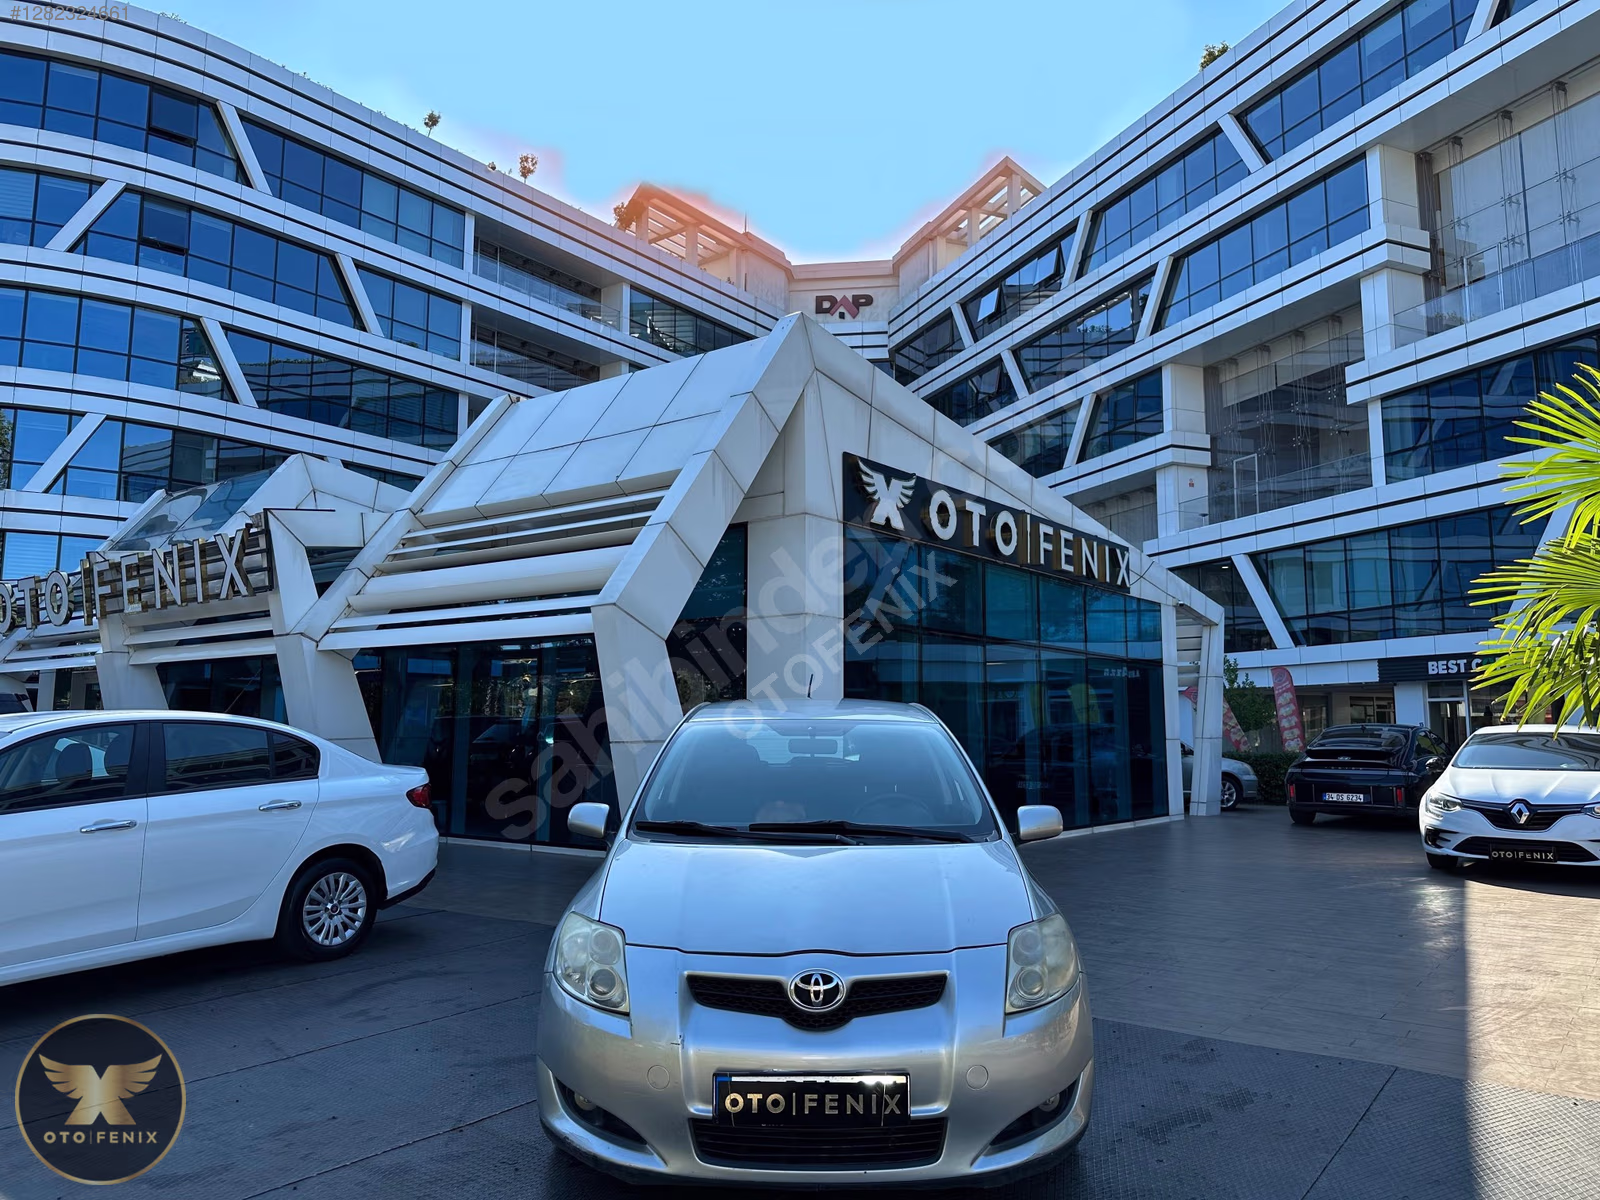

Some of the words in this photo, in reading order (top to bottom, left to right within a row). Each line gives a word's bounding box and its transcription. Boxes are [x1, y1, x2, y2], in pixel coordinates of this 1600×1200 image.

[815, 293, 874, 319] DAP
[928, 489, 1018, 556] OTO
[1038, 521, 1130, 588] FENIX
[93, 528, 250, 618] FENIX
[1427, 659, 1467, 675] BEST
[1518, 851, 1554, 860] FENIX
[724, 1092, 786, 1114] OTO
[804, 1093, 901, 1115] FENIX
